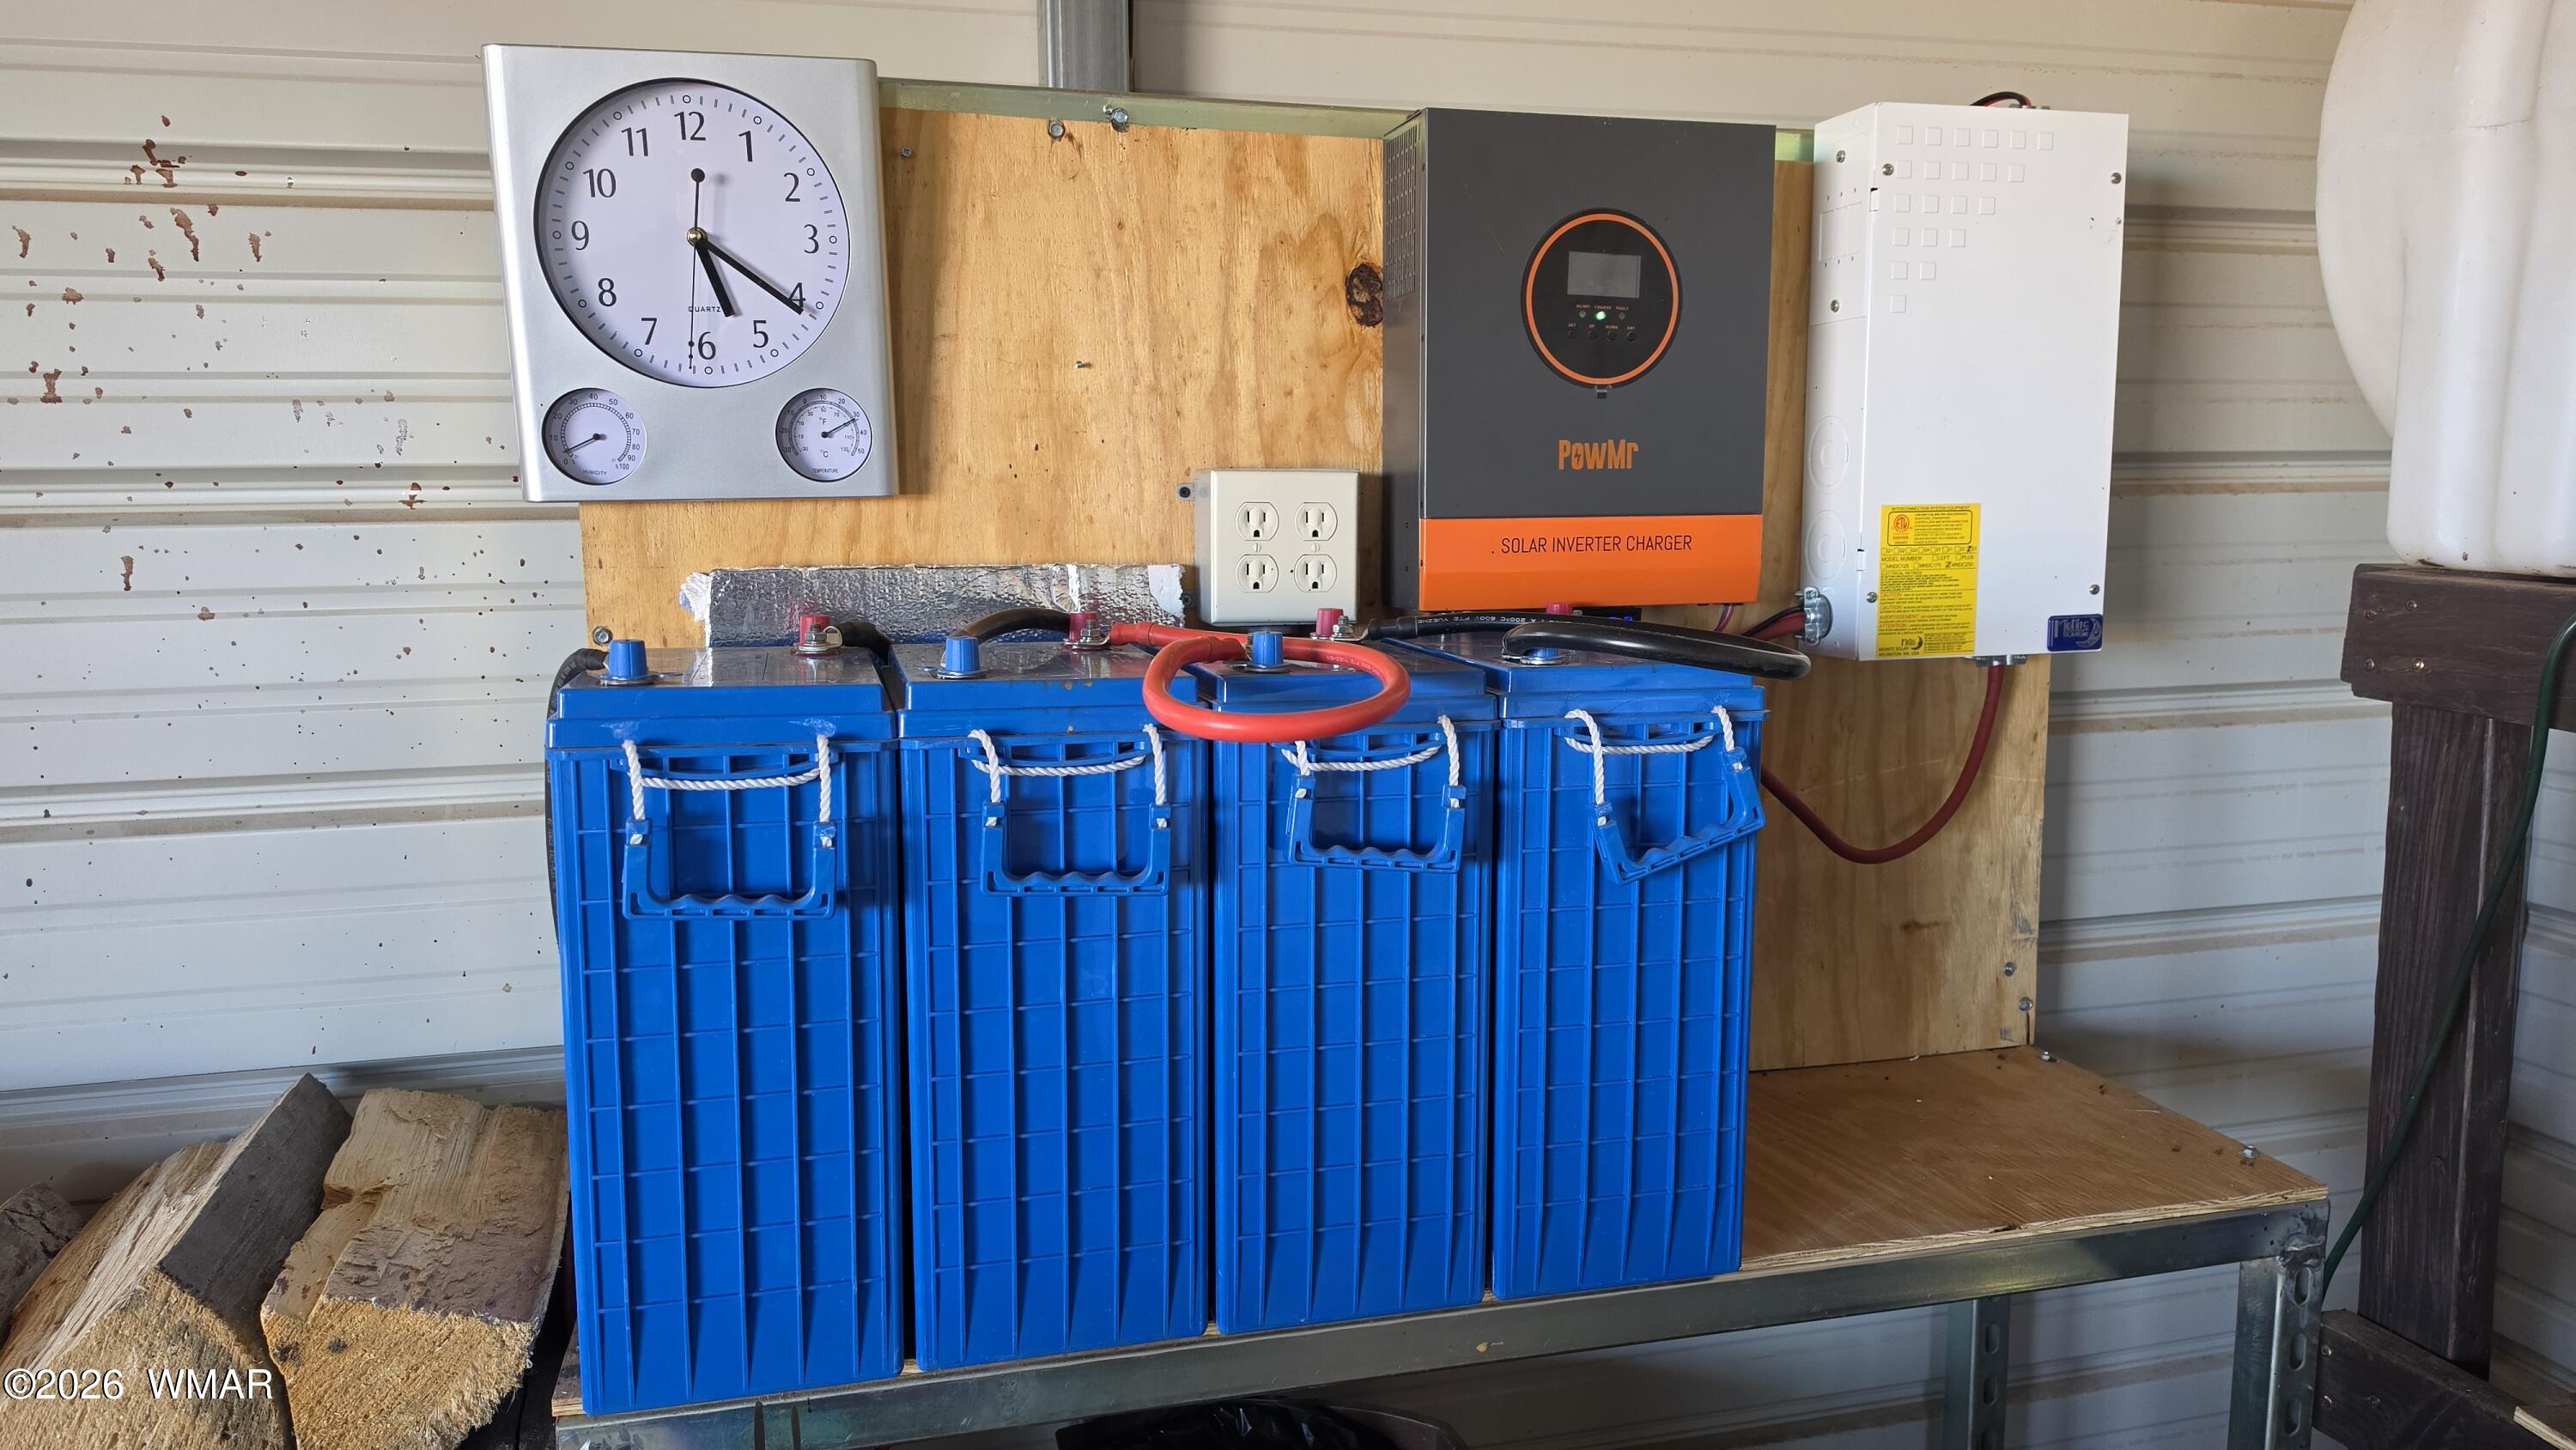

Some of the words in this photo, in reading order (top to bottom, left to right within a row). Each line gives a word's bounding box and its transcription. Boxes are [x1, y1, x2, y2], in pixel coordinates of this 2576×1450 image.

[674, 112, 707, 141] 12
[622, 128, 648, 157] 11
[738, 130, 753, 162] 1
[582, 168, 617, 198] 10
[784, 173, 801, 203] 2
[571, 221, 590, 251] 9
[805, 224, 819, 254] 3
[598, 278, 617, 307] 8
[788, 282, 806, 310] 4
[641, 318, 658, 345] 7
[698, 331, 716, 361] 6
[753, 320, 769, 349] 5
[1558, 439, 1639, 470] PowMr
[1501, 537, 1547, 554] SOLAR
[1552, 536, 1621, 553] INVERTER
[1626, 535, 1692, 551] CHARGER
